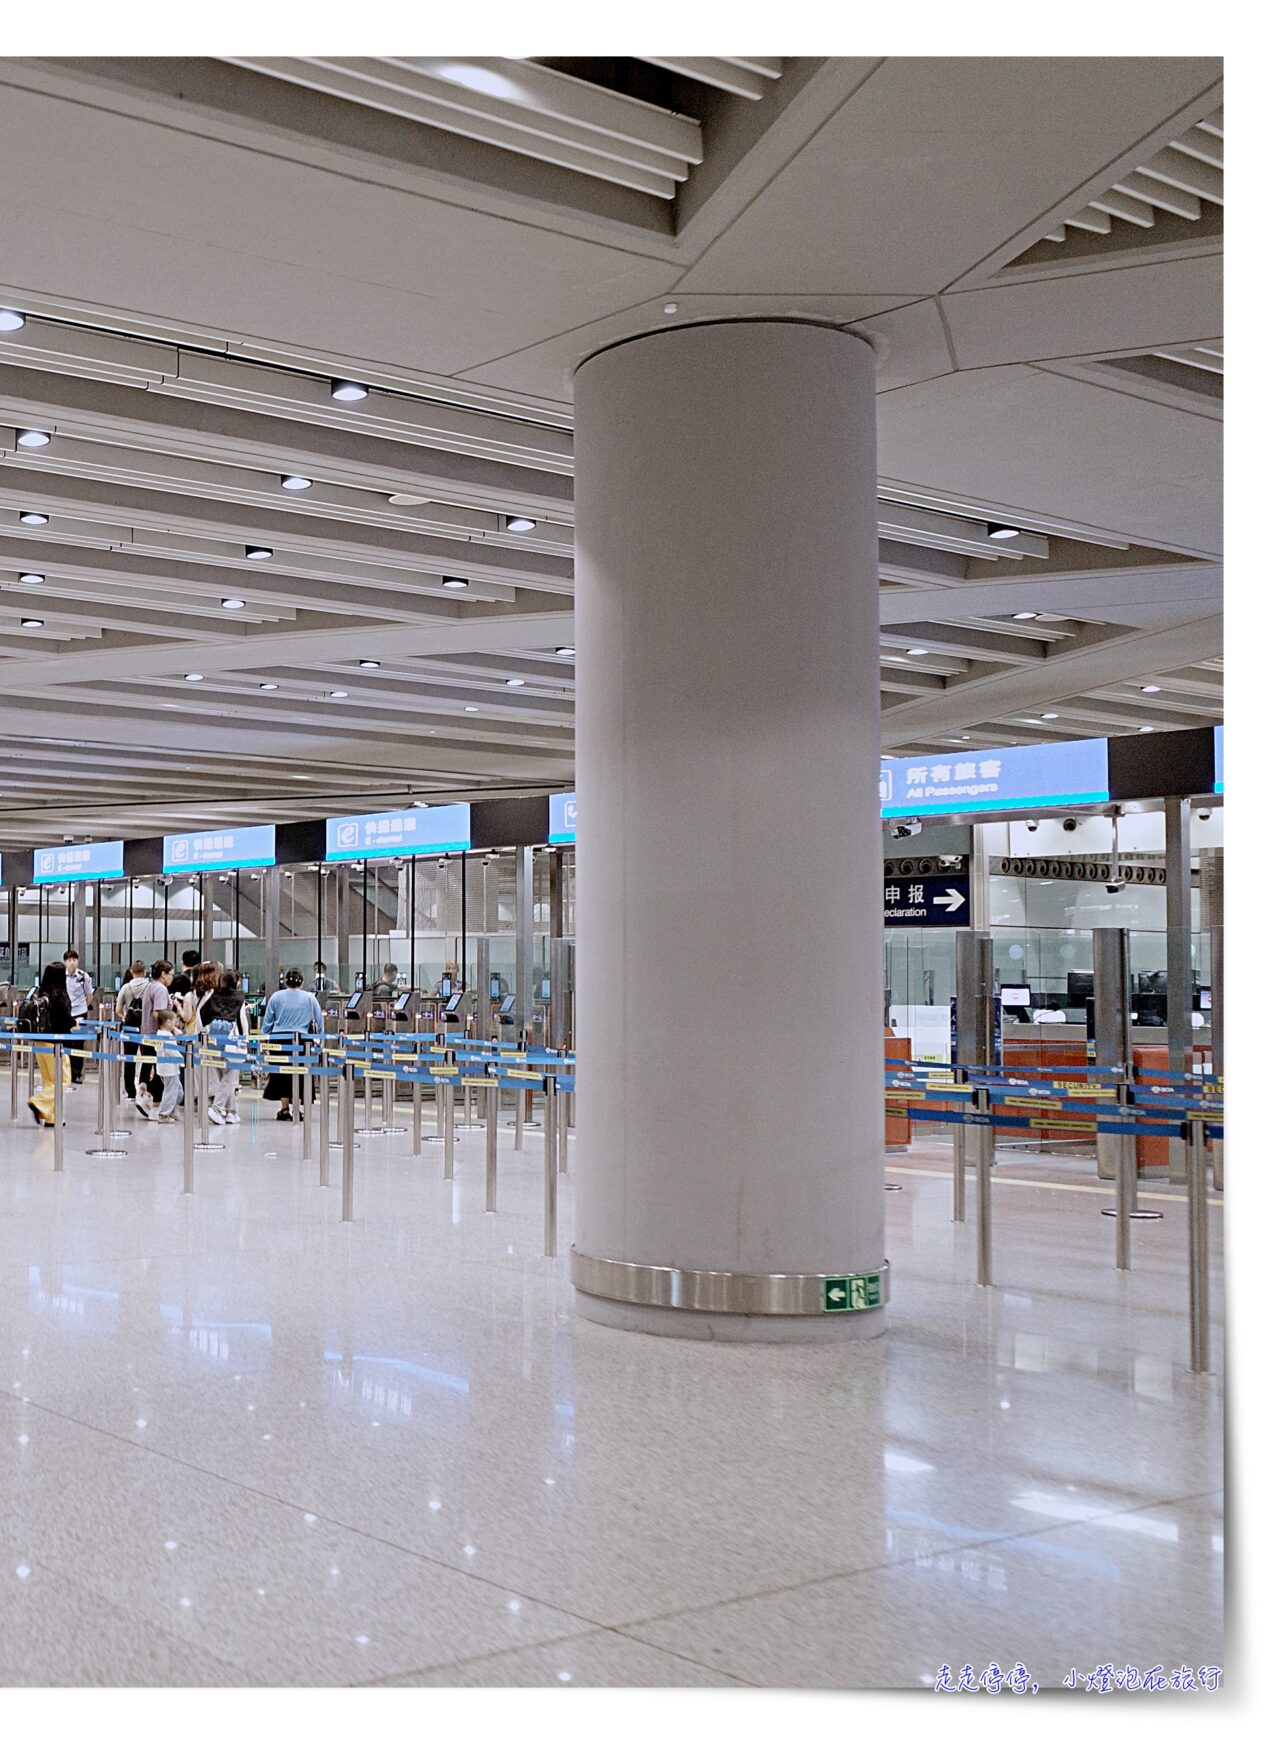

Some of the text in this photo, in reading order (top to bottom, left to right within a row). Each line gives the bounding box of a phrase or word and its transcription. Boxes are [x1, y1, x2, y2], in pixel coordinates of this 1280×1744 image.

[906, 759, 1002, 785] 所有旅客
[906, 783, 998, 798] All Passengers
[885, 884, 925, 904] 申报
[884, 907, 927, 917] eclaration
